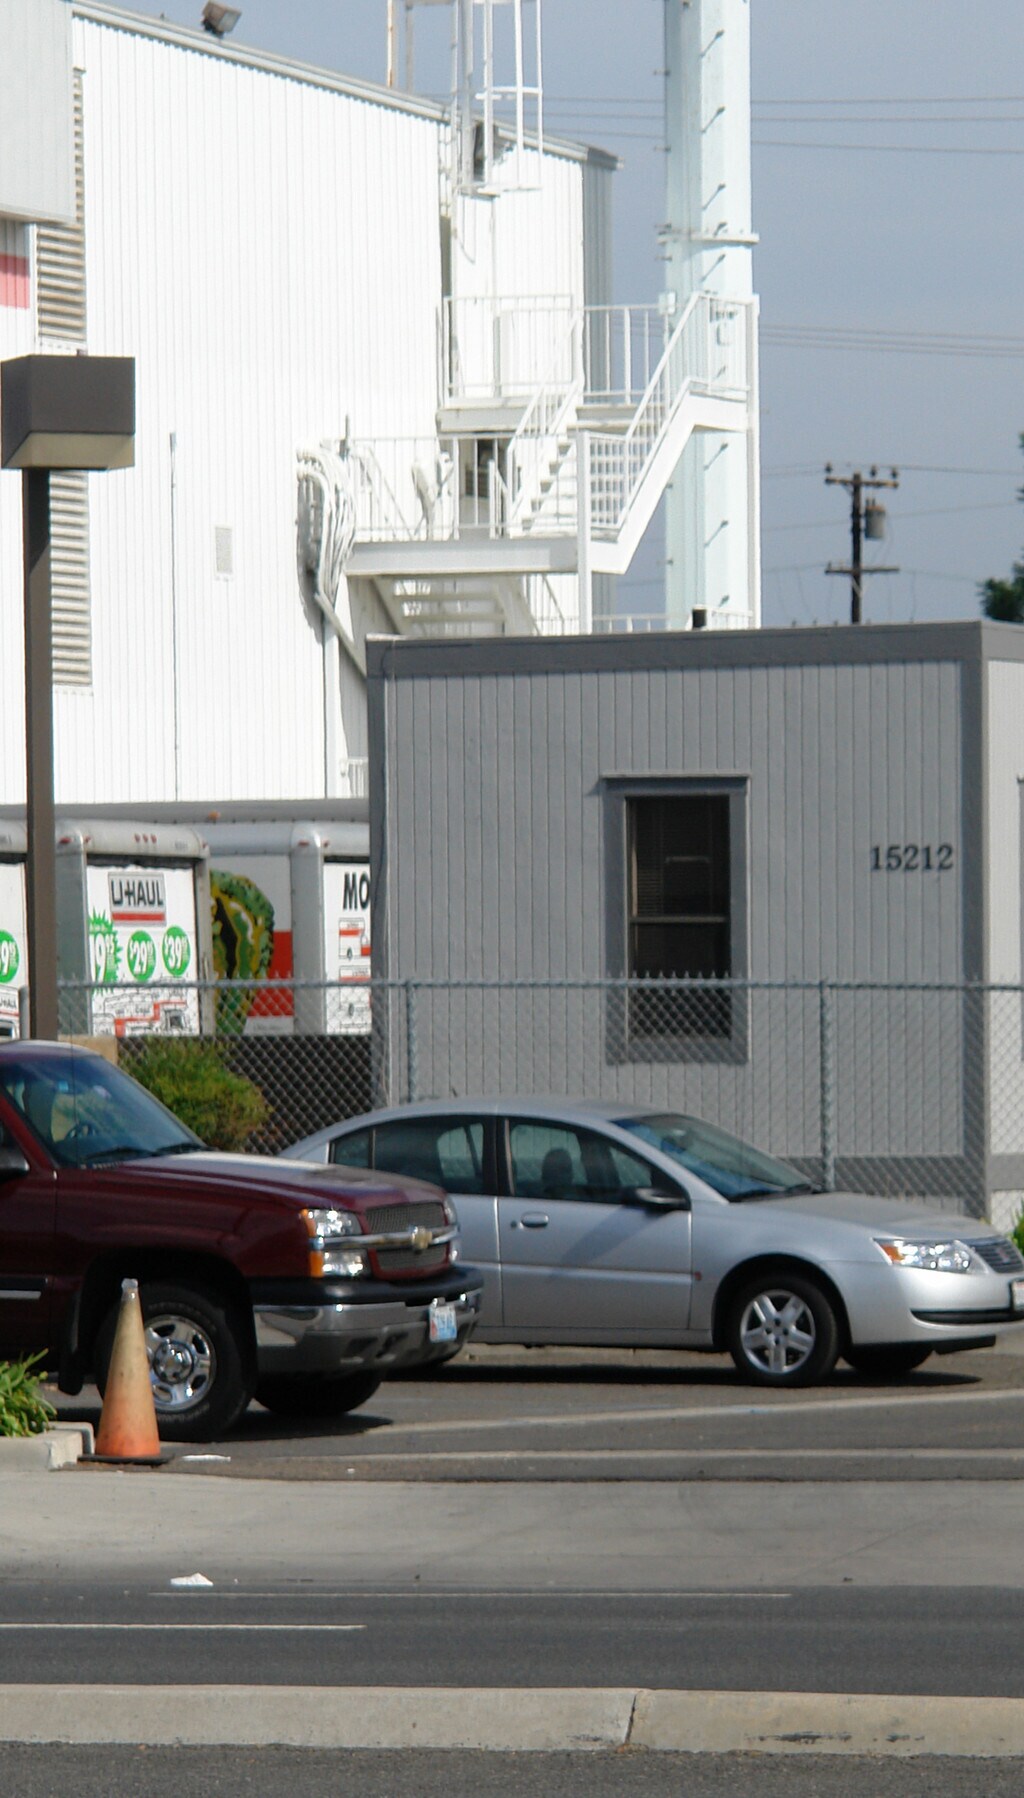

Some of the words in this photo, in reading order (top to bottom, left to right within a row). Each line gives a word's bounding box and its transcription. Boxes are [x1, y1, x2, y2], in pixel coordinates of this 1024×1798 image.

[870, 845, 953, 872] 15212
[111, 879, 164, 907] U-HAUL
[343, 872, 371, 911] MO
